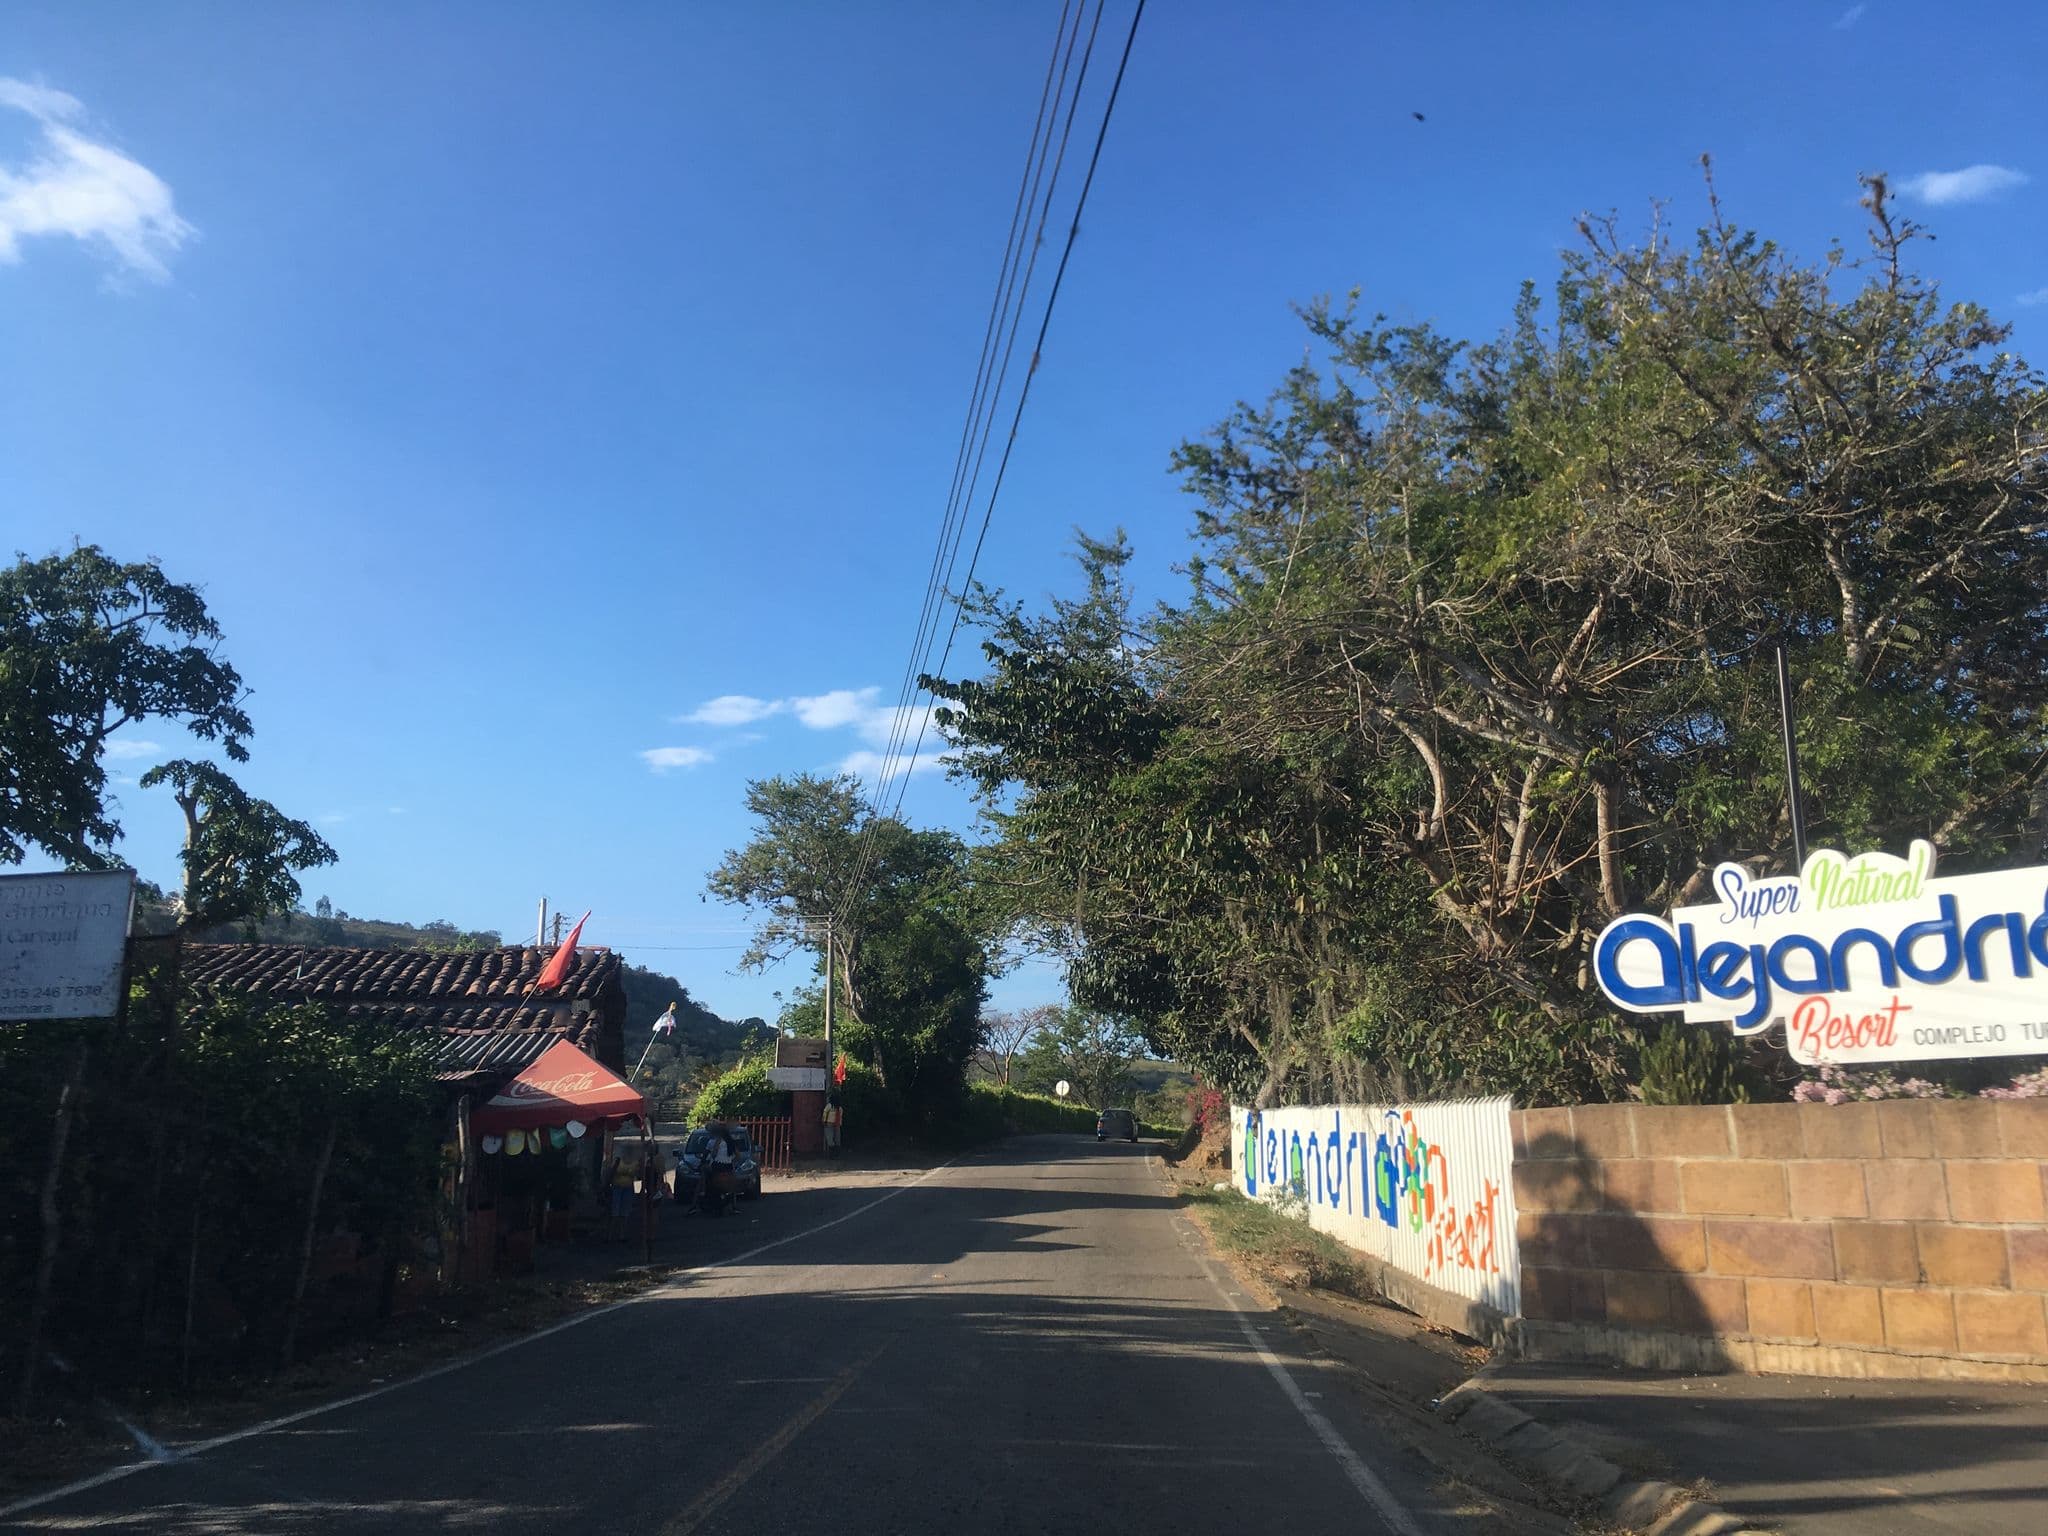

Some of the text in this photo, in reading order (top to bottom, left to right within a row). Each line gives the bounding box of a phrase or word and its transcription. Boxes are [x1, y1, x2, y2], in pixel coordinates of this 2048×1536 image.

[1720, 848, 1924, 928] Super Natural
[1792, 995, 1912, 1056] Resort
[1914, 1024, 2006, 1046] COMPLEJO
